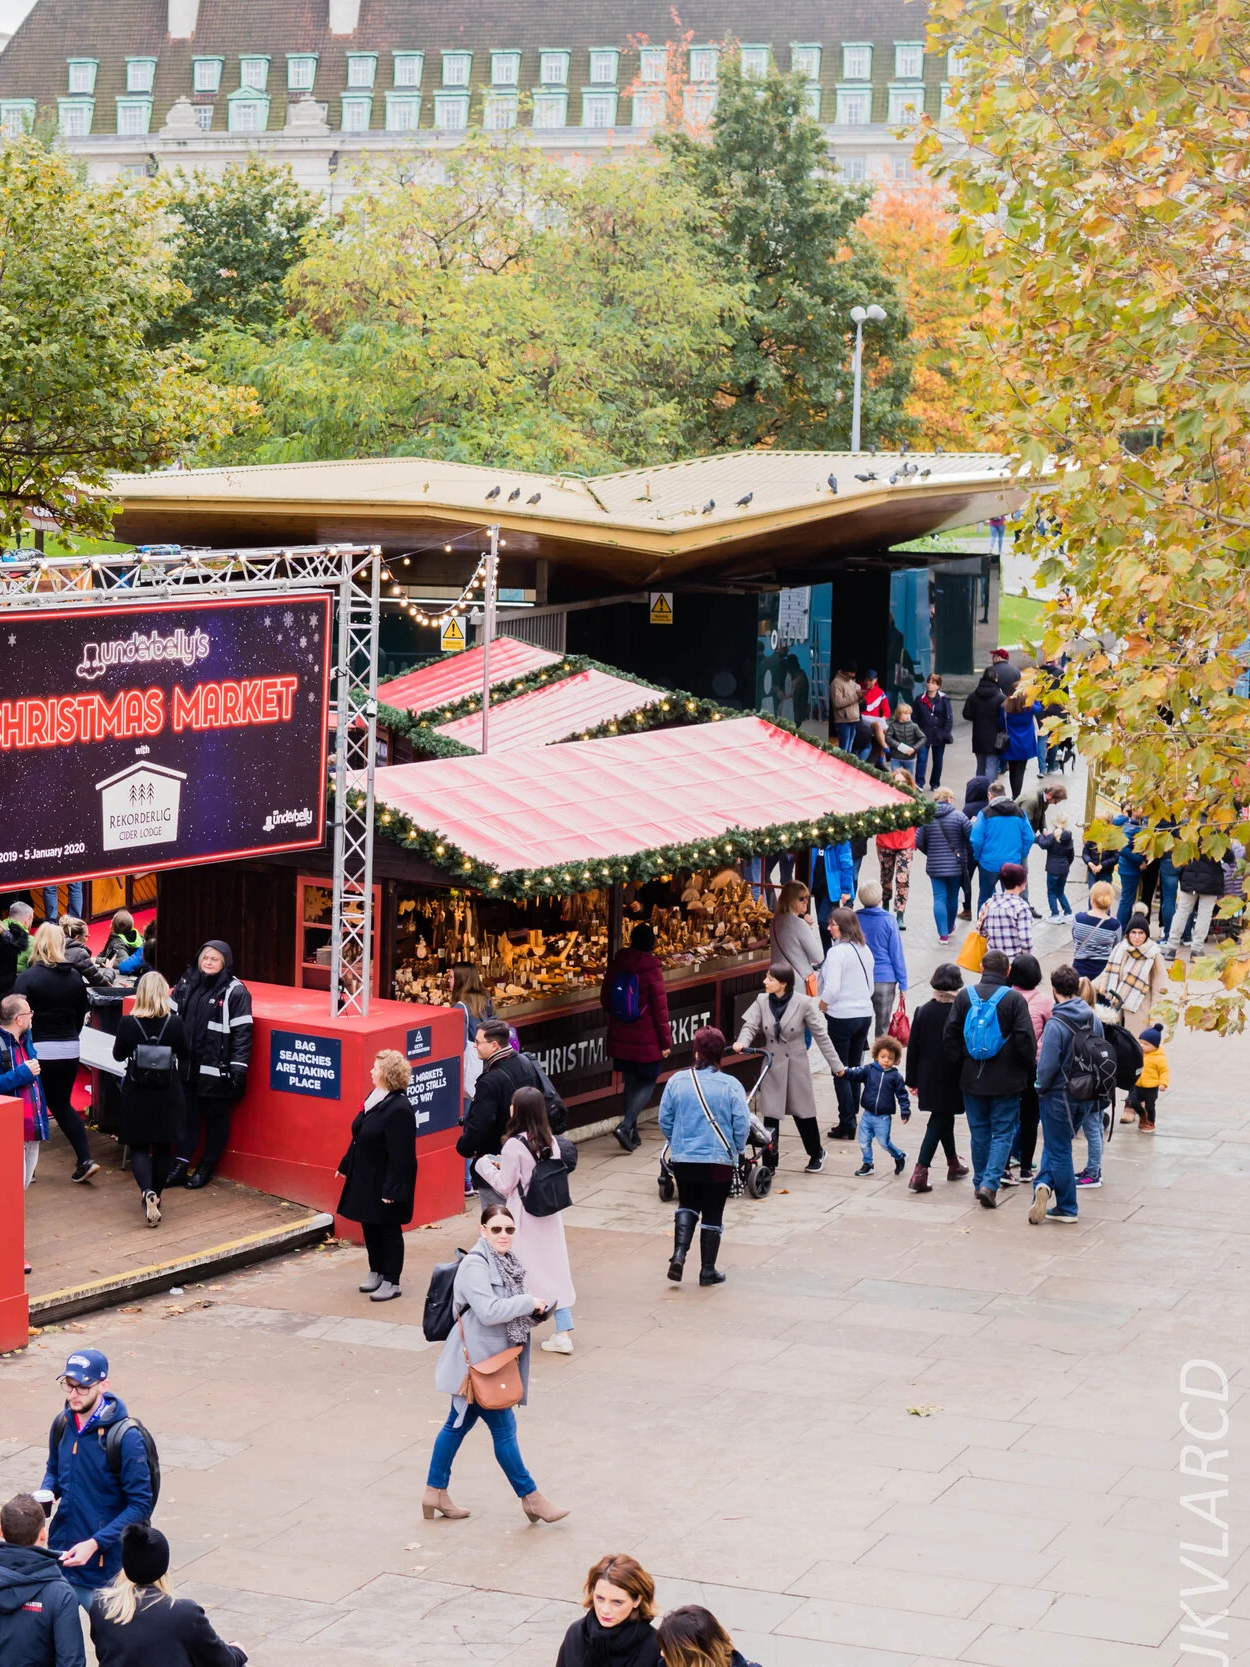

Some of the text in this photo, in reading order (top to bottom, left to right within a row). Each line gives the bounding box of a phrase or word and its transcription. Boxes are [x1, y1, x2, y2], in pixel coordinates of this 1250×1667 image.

[101, 627, 210, 666] underbelly's
[174, 676, 298, 732] MARKET
[135, 745, 150, 755] with
[110, 808, 171, 829] REKORDERLIG
[273, 808, 313, 824] underbelly
[119, 826, 162, 841] CIDER LODGE
[24, 849, 30, 860] 5
[31, 846, 63, 859] January
[64, 842, 85, 855] 2020
[295, 1039, 316, 1052] BAG
[532, 1011, 711, 1076] HRISTM RKET
[279, 1050, 332, 1066] SEARCHES
[275, 1061, 335, 1080] ARE TAKING
[416, 1068, 443, 1083] MARKETS
[289, 1076, 321, 1090] PLACE
[406, 1083, 425, 1096] FOOD
[426, 1077, 447, 1091] STALLS
[408, 1092, 434, 1106] HIS WAY
